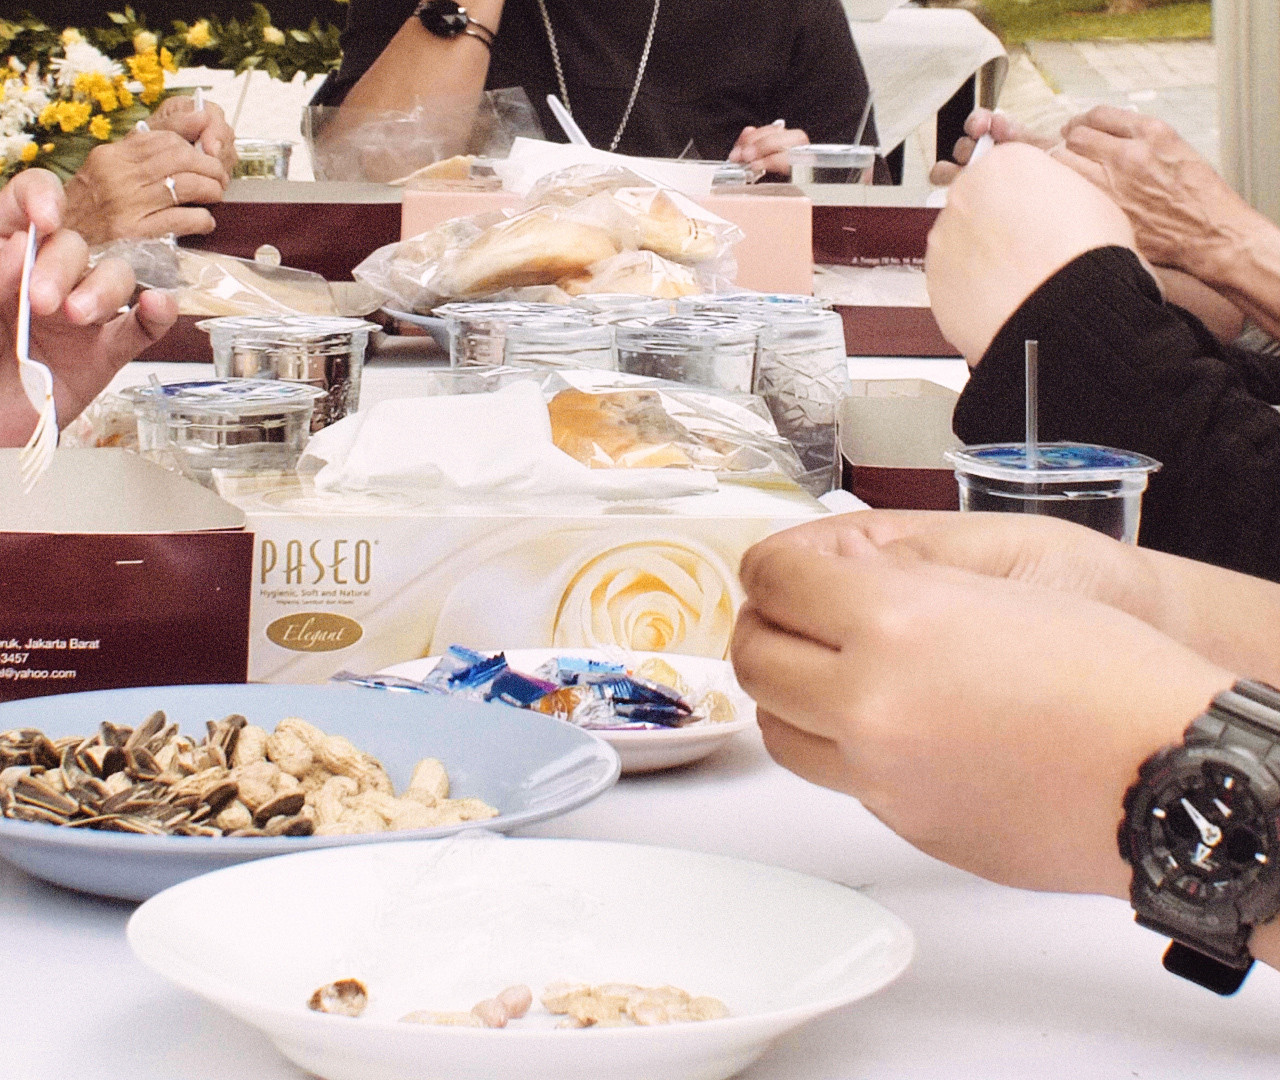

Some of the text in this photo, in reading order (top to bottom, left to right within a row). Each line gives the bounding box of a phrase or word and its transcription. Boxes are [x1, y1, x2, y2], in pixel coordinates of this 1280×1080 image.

[261, 539, 372, 585] PASEO
[321, 589, 338, 597] and
[340, 589, 371, 597] Natural
[24, 638, 67, 649] Jakarta
[69, 638, 100, 649] Barat
[283, 616, 345, 649] Elegant
